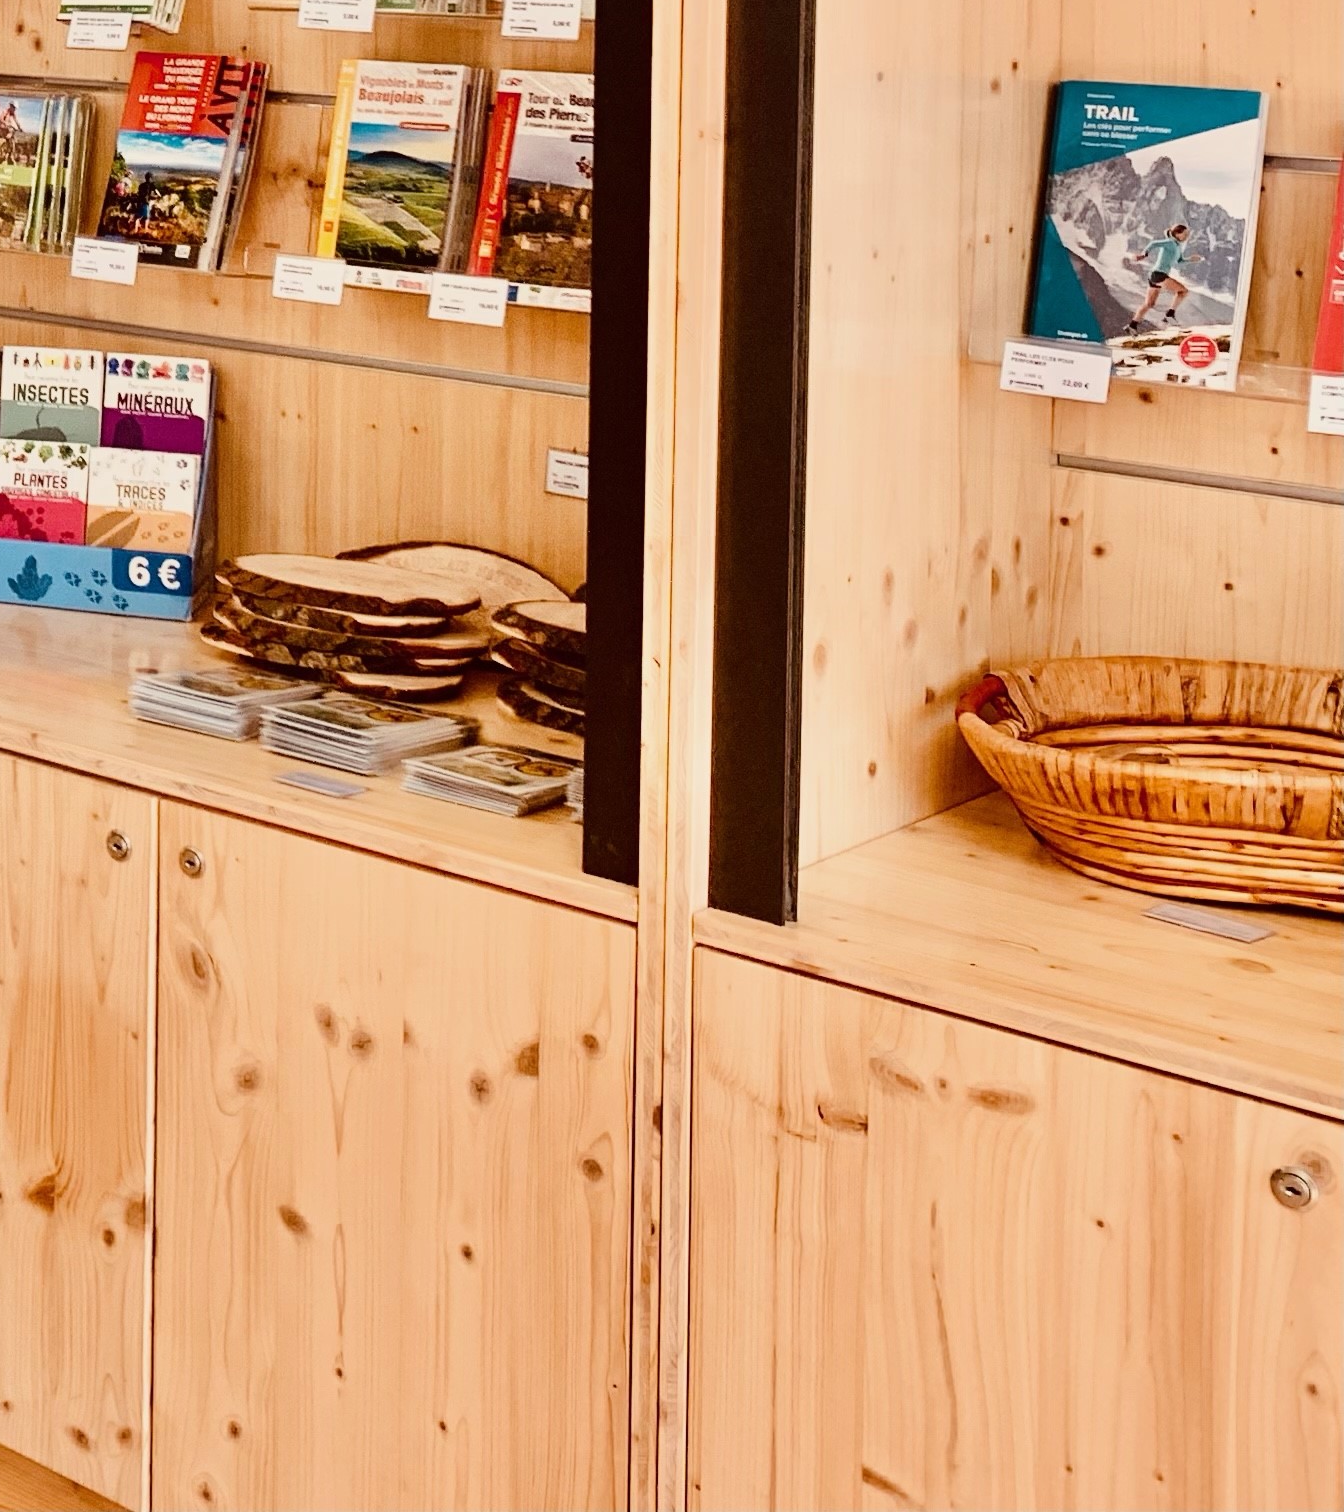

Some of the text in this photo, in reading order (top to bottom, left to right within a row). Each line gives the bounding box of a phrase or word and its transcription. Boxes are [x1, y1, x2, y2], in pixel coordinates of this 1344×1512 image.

[164, 58, 206, 68] LA GRANDE
[360, 75, 407, 88] Vignobles
[415, 79, 444, 90] Monts
[150, 95, 176, 104] GRAND
[177, 97, 197, 106] TOUR
[528, 92, 550, 104] Tour
[525, 108, 590, 122] des Pierres
[1084, 104, 1139, 122] TRAIL
[1113, 124, 1132, 132] pour
[1132, 125, 1172, 134] performer
[13, 384, 89, 406] INSECTES
[117, 391, 194, 416] MINÉRAUX
[14, 473, 68, 489] PLANTES
[116, 484, 166, 501] TRACES
[129, 500, 163, 512] INDICES
[128, 555, 181, 590] 6 €
